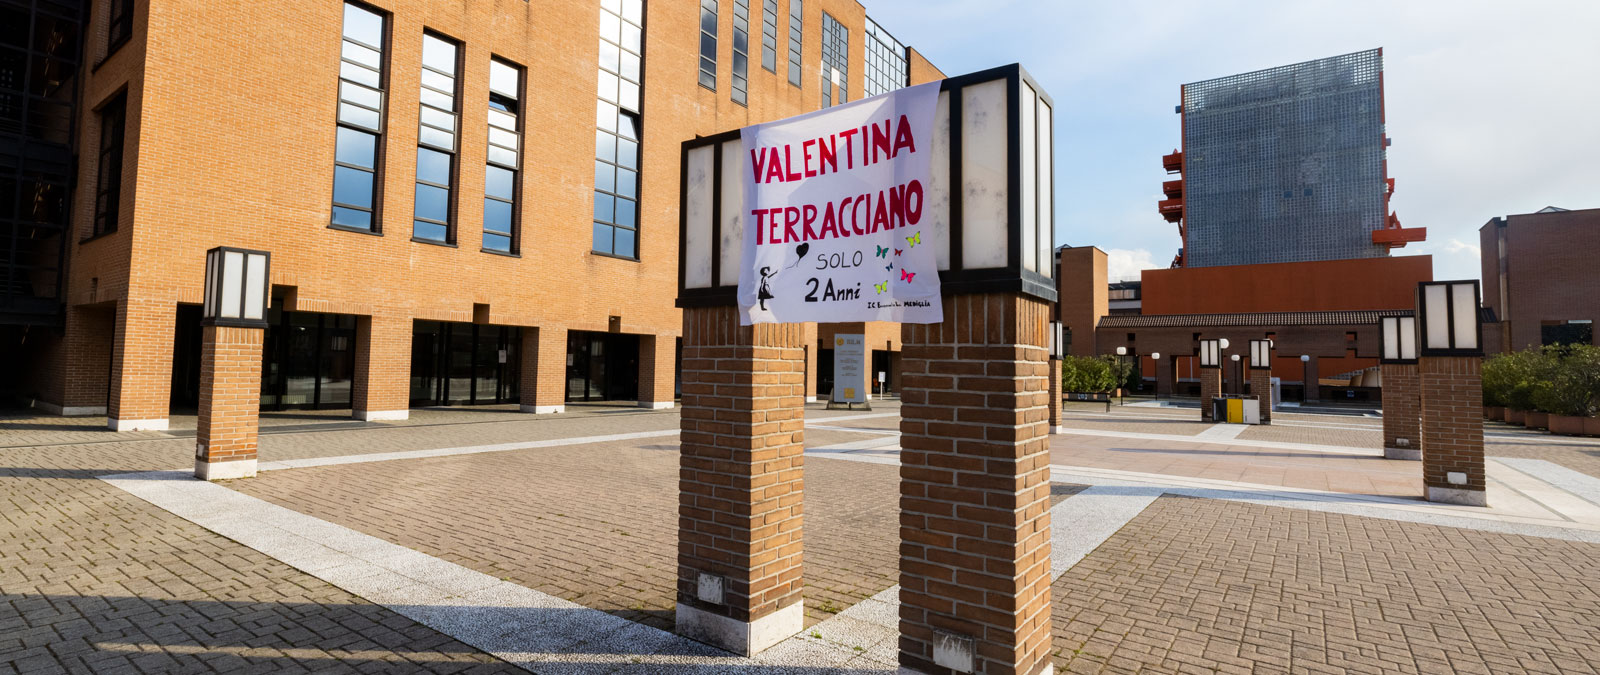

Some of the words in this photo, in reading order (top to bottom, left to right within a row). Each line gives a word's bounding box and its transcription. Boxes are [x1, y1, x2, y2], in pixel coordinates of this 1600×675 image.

[751, 115, 916, 184] VALENTINA
[751, 179, 924, 246] TERRACCIANO
[815, 250, 863, 270] SOLO
[804, 277, 819, 303] 2
[822, 277, 861, 302] Anni
